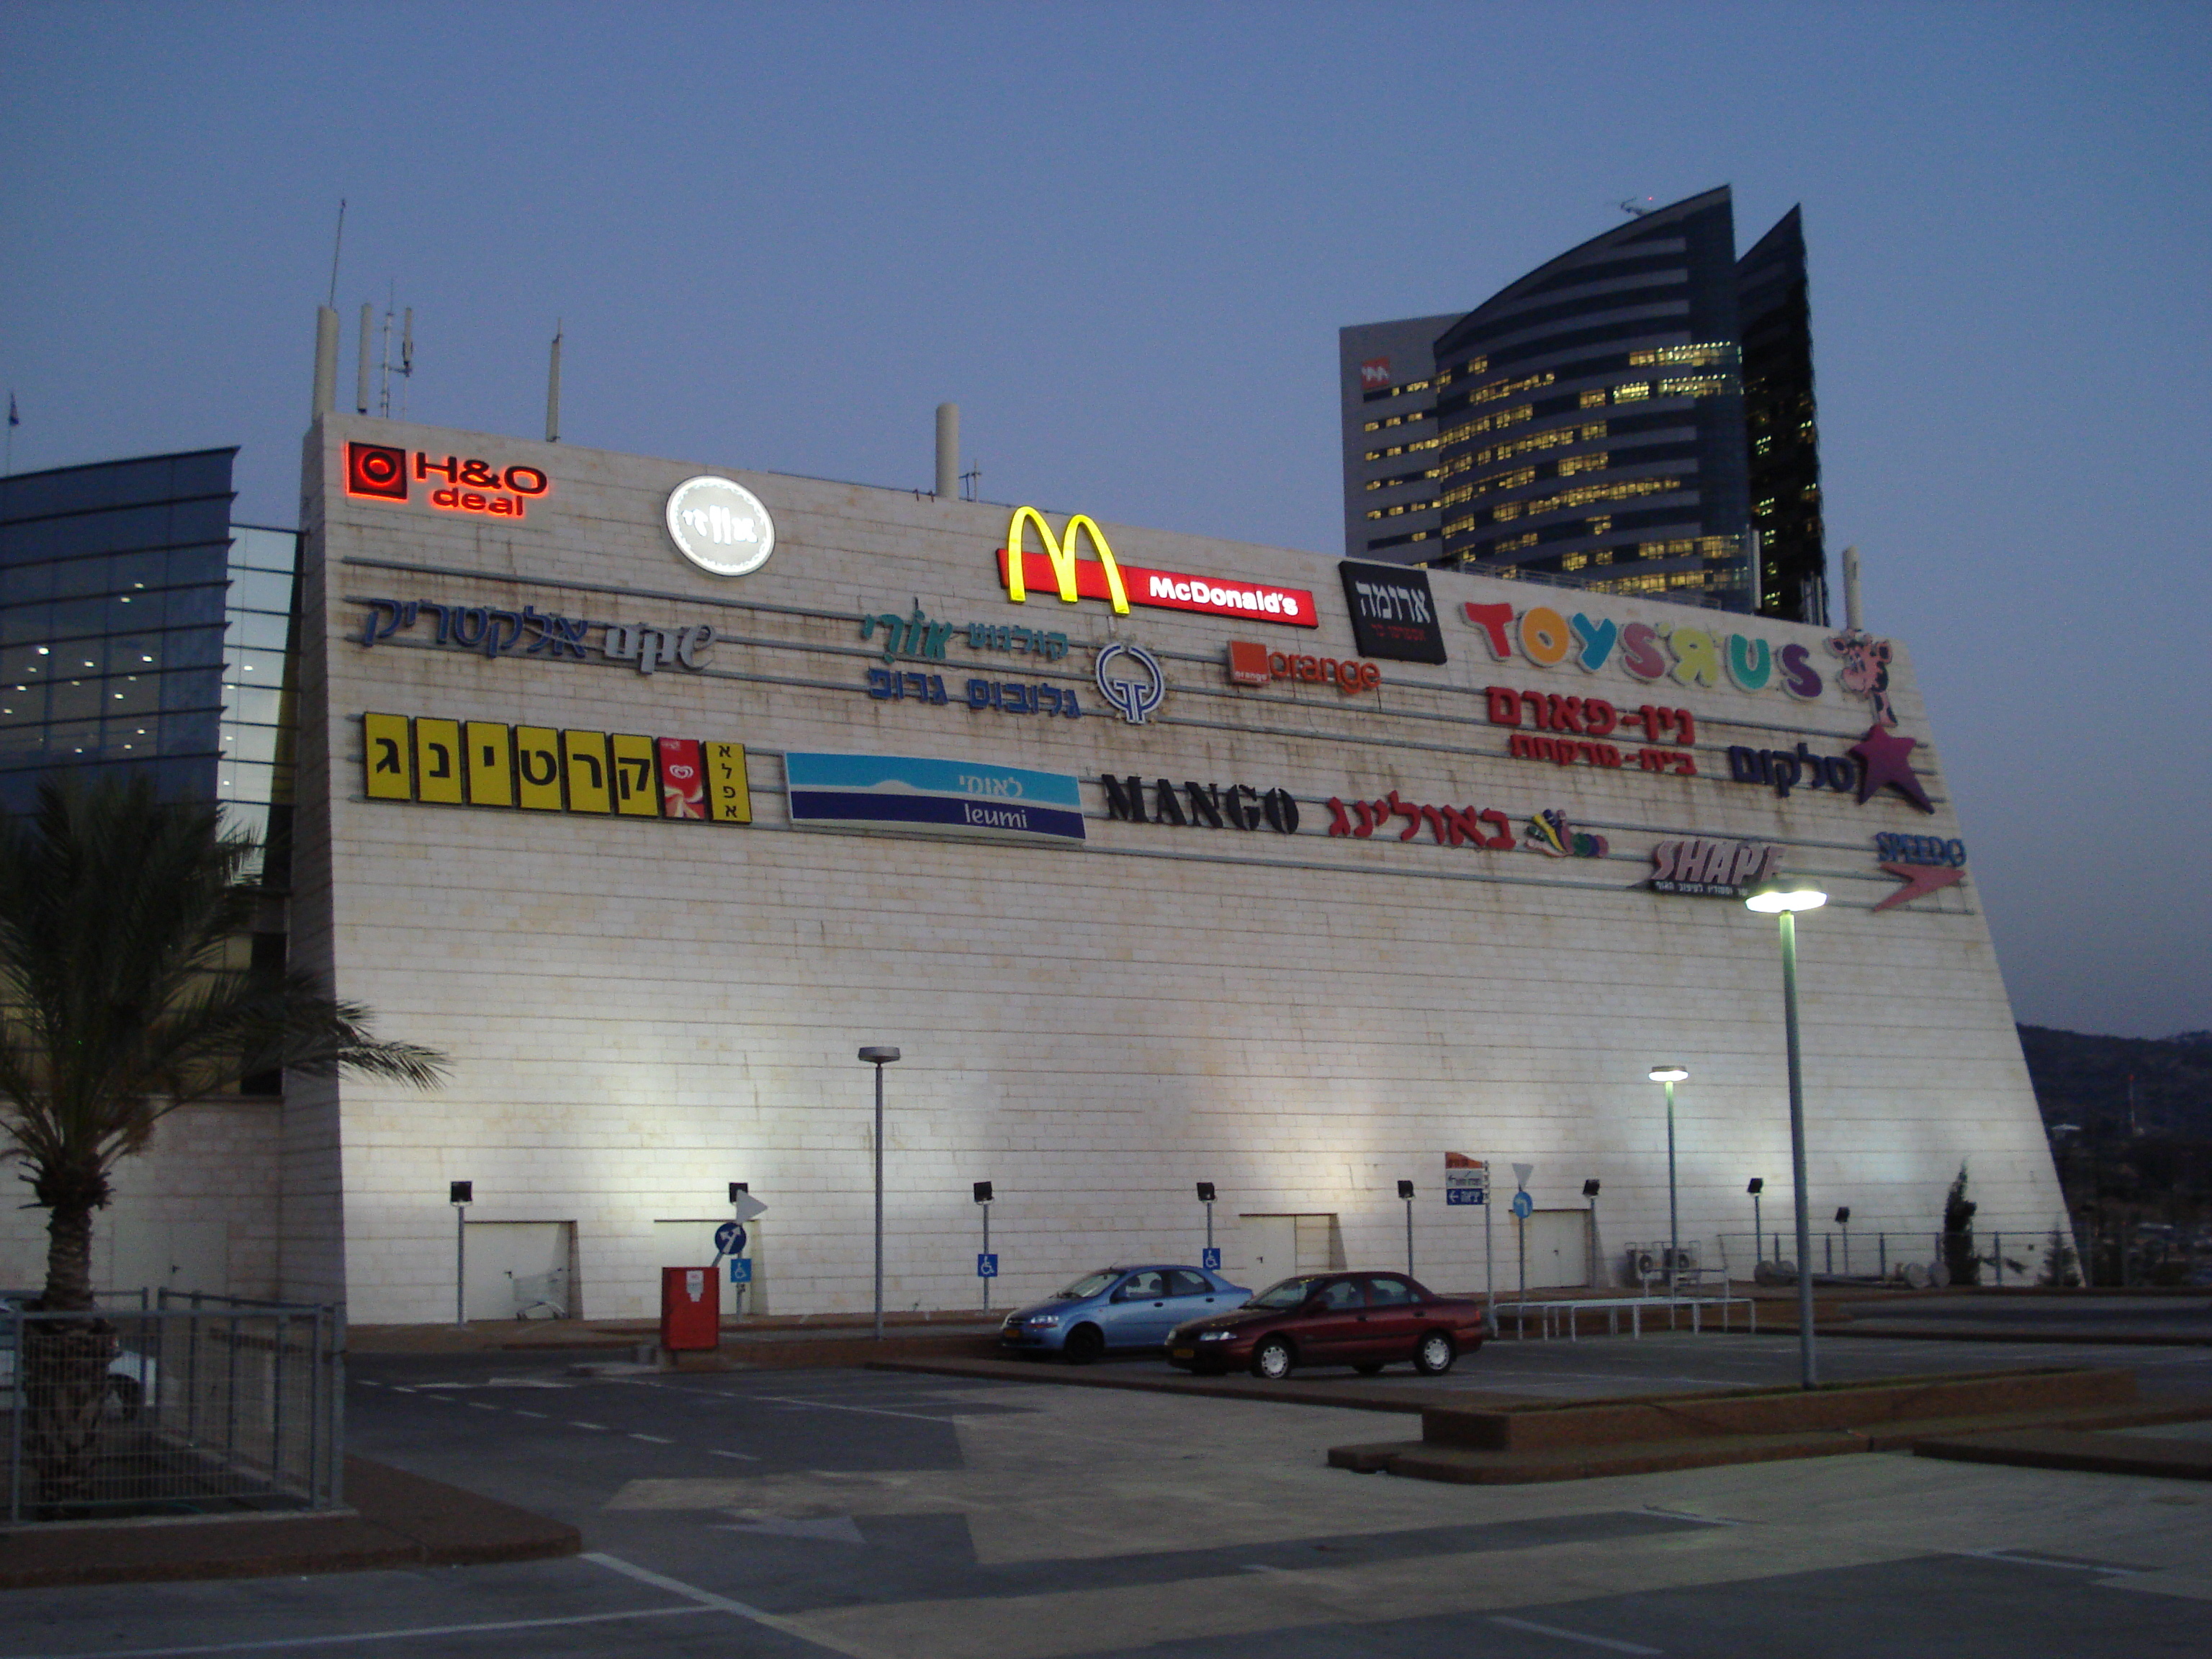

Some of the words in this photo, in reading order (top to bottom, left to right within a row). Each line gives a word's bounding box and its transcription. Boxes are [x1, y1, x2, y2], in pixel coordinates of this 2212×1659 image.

[413, 451, 549, 496] H&O
[432, 487, 524, 516] deal
[1148, 575, 1300, 617] McDonald's
[1355, 580, 1431, 624] ארומה
[362, 596, 589, 659] אלקטריק
[868, 665, 949, 706] גרופ
[1268, 651, 1382, 695] orange
[968, 678, 1082, 719] גלובוס
[375, 737, 651, 801] קרטינג
[958, 775, 1023, 799] לאומי
[1729, 742, 1857, 797] סלקום
[964, 802, 1029, 829] leumi
[1101, 773, 1300, 835] MANGO
[1328, 789, 1516, 850] באולינג
[1876, 831, 1967, 868] SPEEDO
